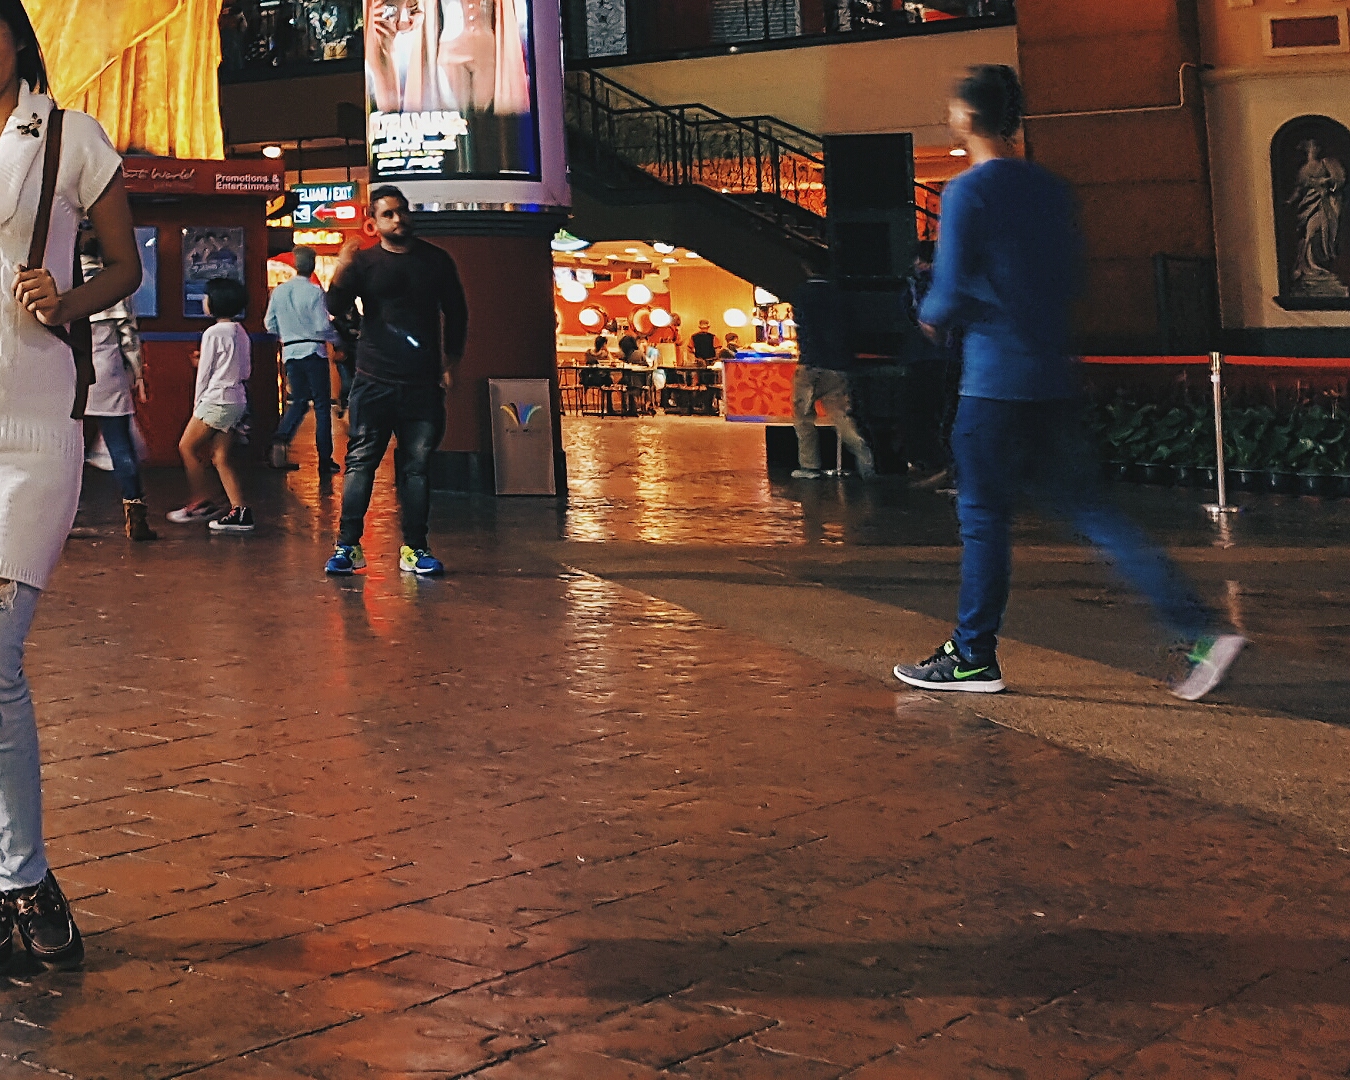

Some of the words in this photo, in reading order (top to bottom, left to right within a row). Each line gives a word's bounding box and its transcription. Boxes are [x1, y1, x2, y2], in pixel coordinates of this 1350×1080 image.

[215, 173, 268, 182] Promotions
[271, 173, 280, 182] &
[215, 182, 280, 191] Entertainment
[295, 187, 328, 201] ELUAR
